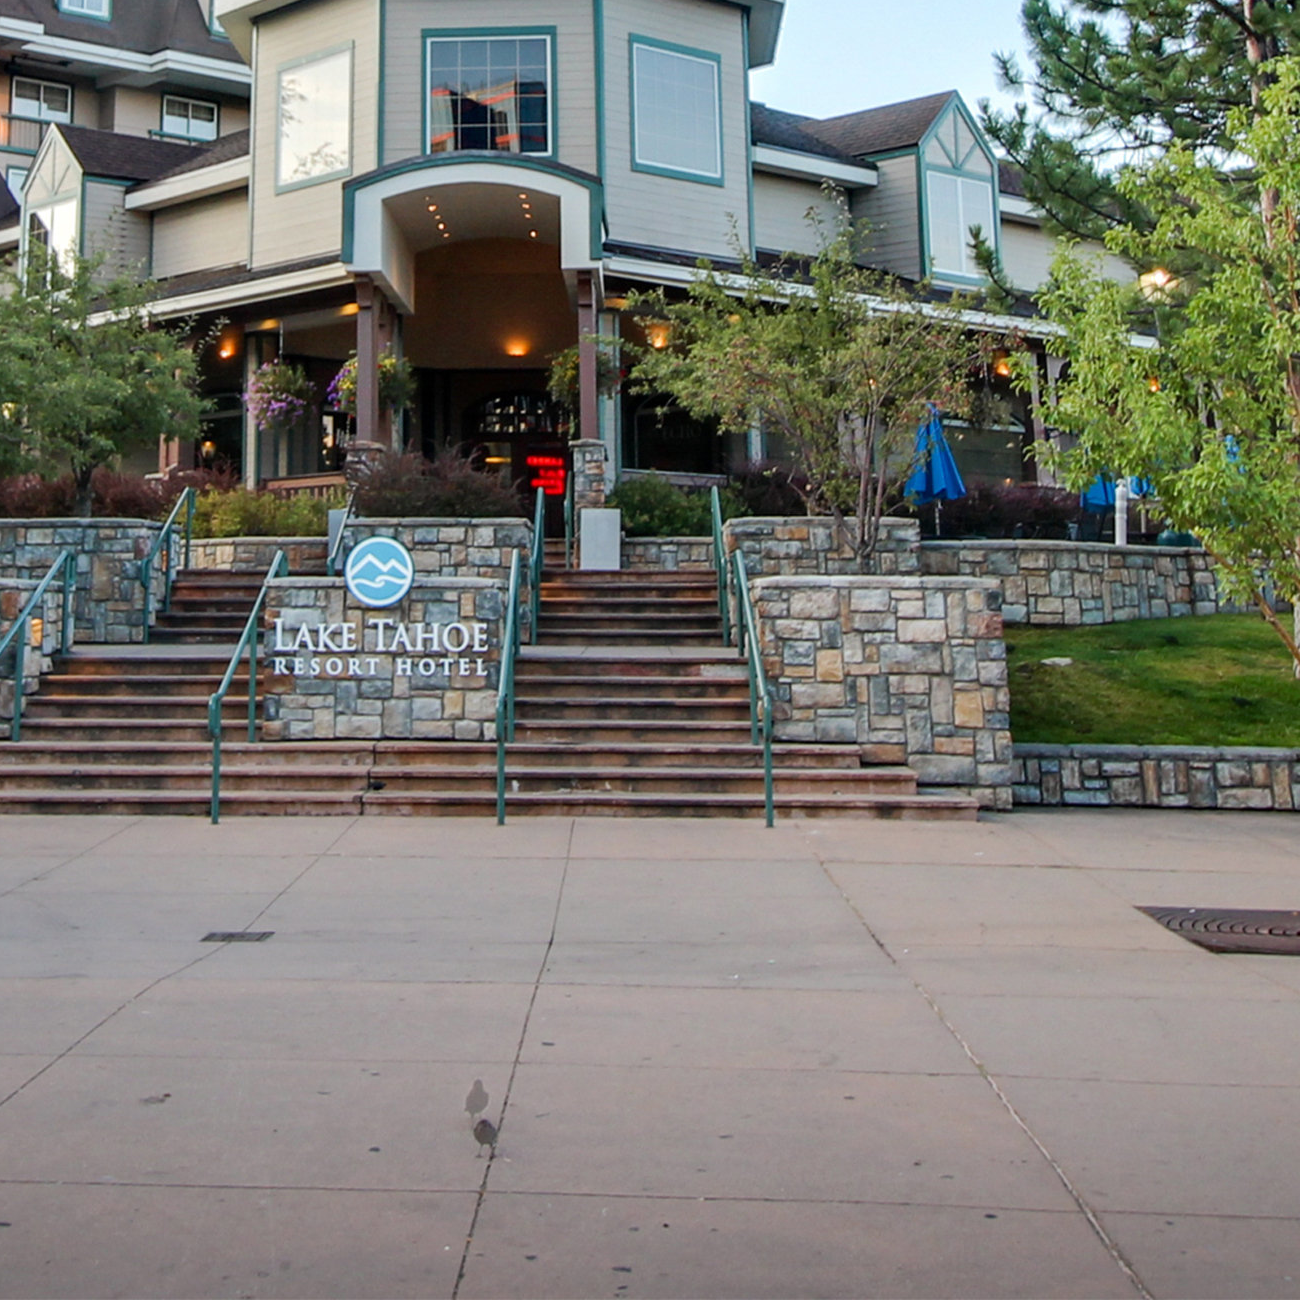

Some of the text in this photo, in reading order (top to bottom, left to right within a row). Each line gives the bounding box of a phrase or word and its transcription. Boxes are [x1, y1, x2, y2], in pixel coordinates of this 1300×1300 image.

[273, 618, 489, 652] LAKE TAHOE
[273, 657, 488, 676] RESORT HOTEL
